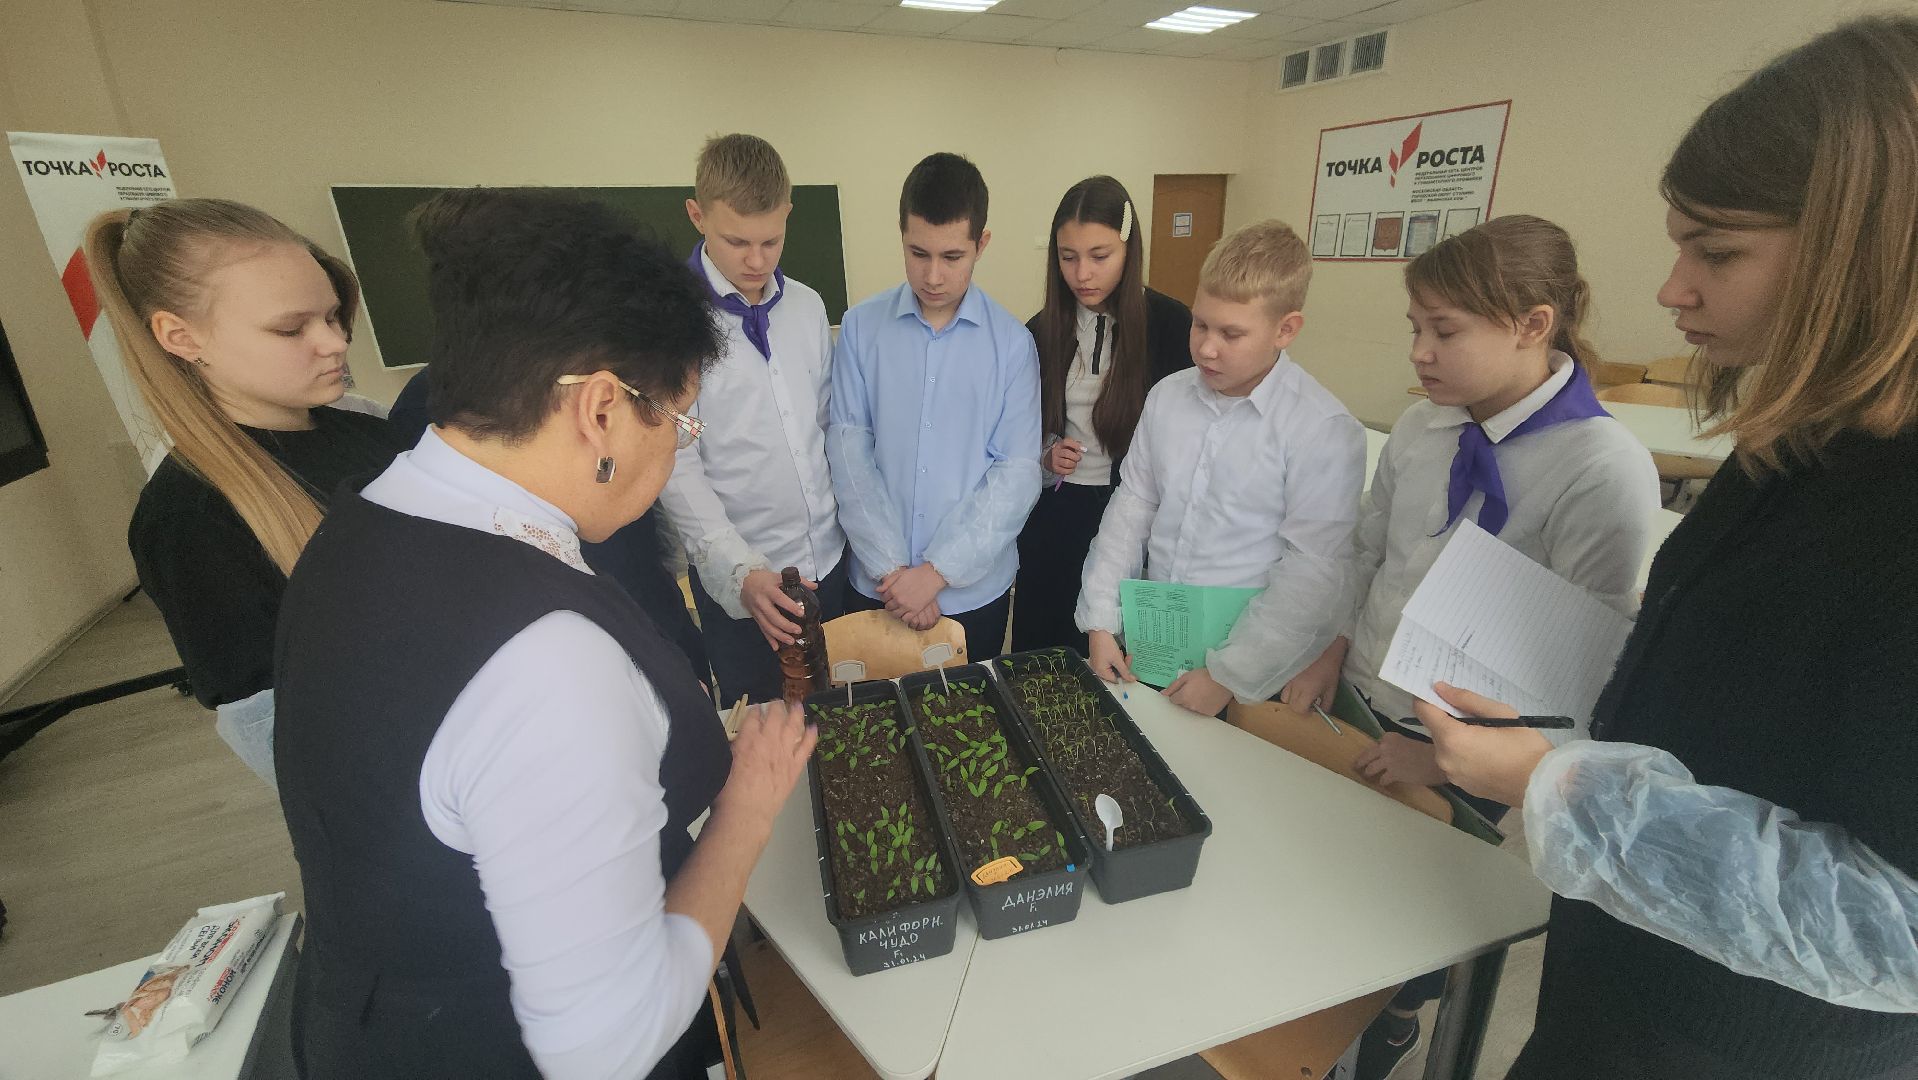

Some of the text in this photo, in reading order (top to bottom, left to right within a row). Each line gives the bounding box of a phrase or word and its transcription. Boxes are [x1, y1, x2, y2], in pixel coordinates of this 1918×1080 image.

[22, 160, 167, 178] ТОЧКА РОСТА
[1326, 144, 1486, 178] ТОЧКА РОСТА
[1001, 881, 1073, 911] ДАНЭЛИЯ
[879, 932, 919, 950] ЧУДО
